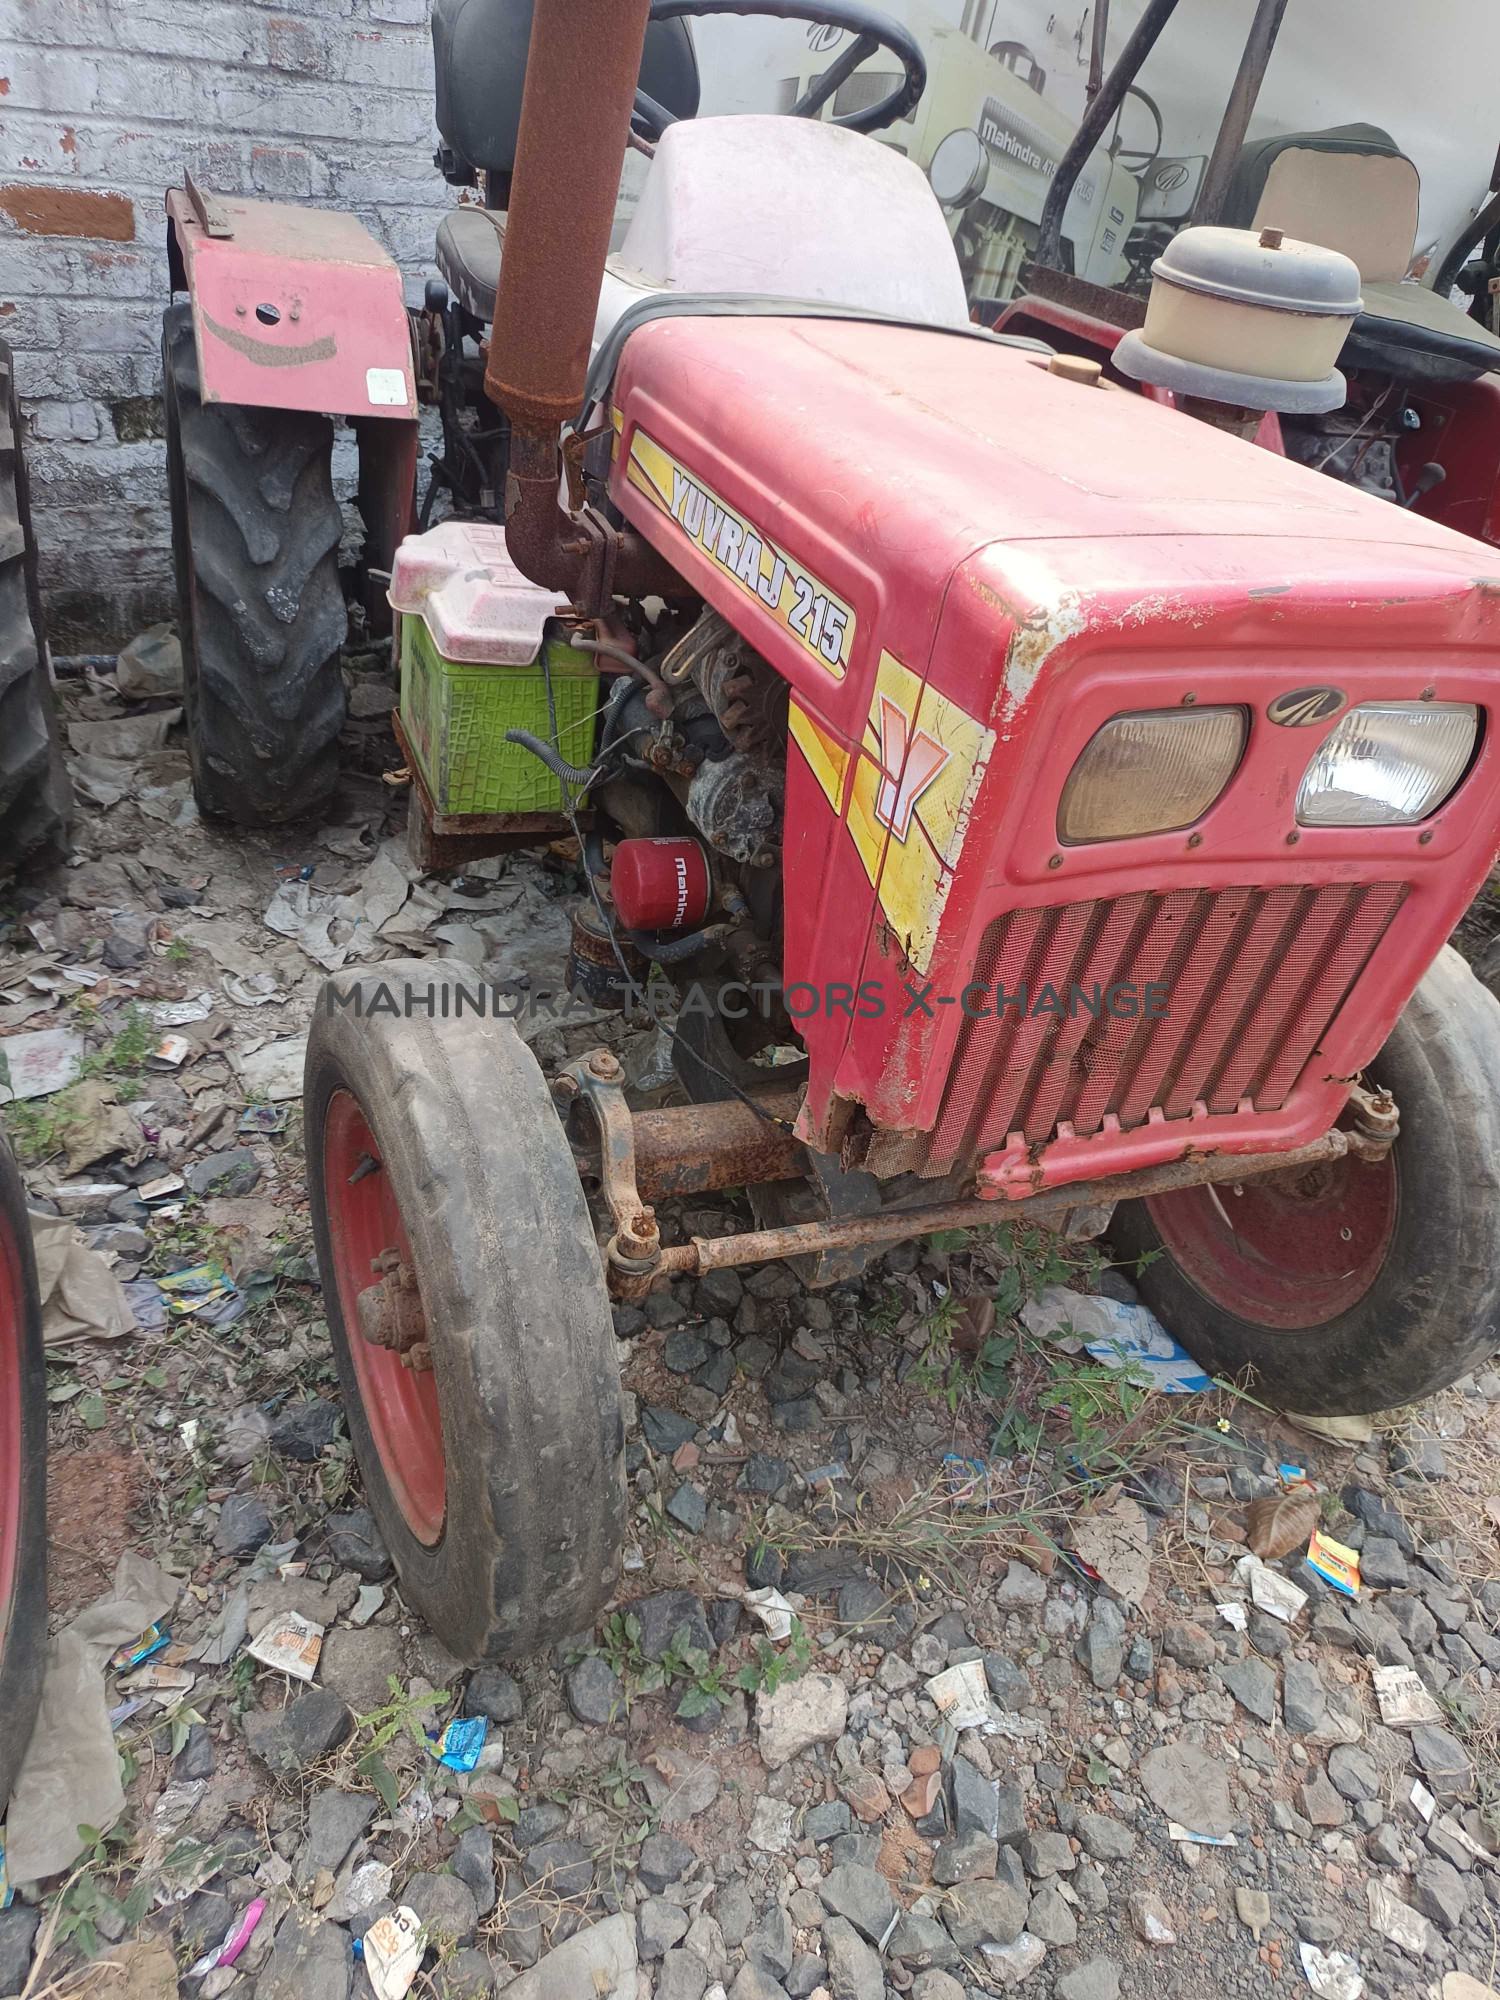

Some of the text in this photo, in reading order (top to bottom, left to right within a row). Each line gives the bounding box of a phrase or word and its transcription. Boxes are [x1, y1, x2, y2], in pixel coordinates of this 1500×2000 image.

[981, 118, 1041, 170] Mahindra
[670, 467, 849, 665] YUVRAJ 215
[672, 857, 689, 927] Mahind
